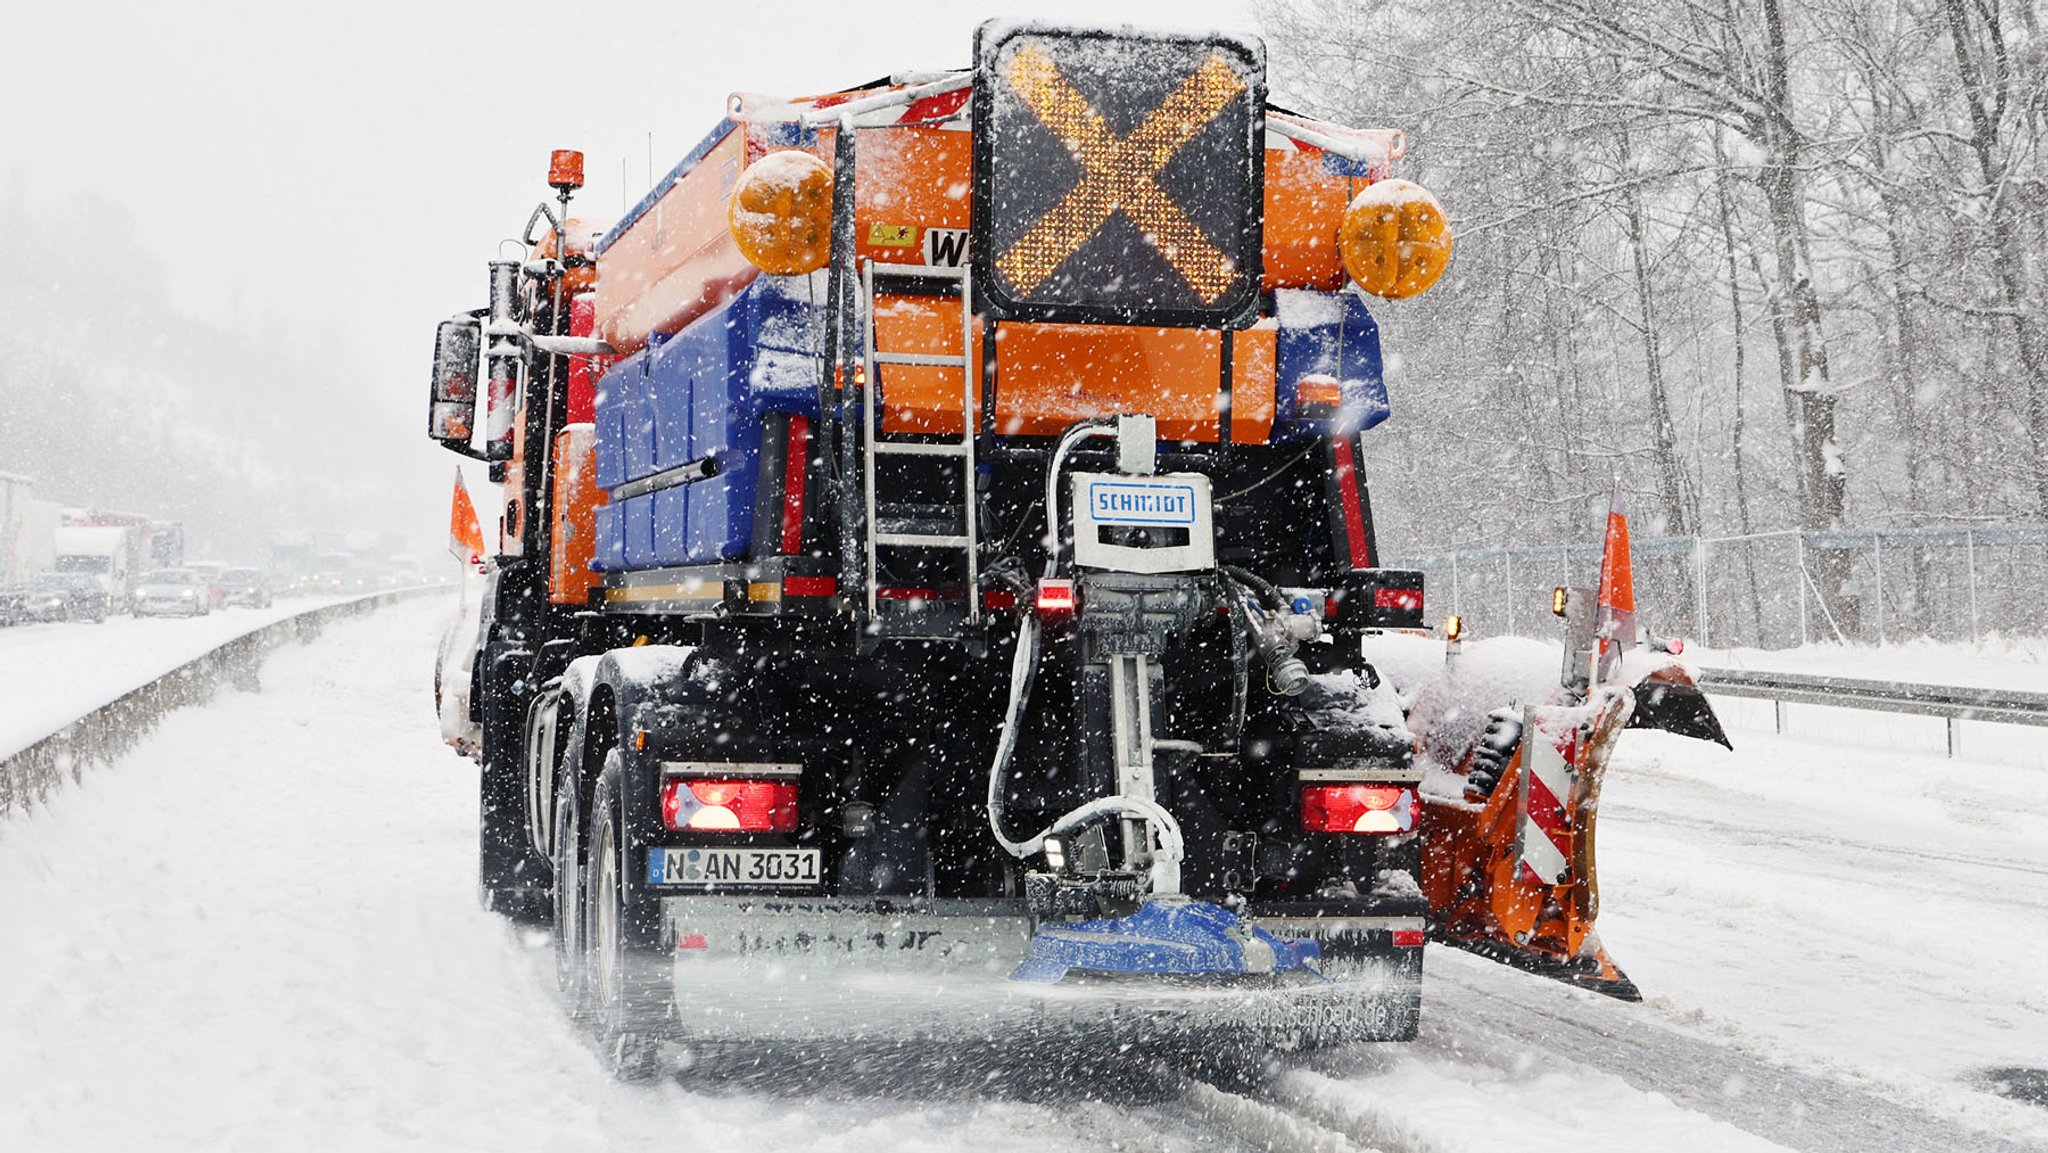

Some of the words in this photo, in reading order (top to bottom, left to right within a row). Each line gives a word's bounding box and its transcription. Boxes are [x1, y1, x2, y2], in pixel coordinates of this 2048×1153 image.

[1099, 493, 1185, 513] SCHMIDT
[666, 853, 684, 879] N
[704, 853, 740, 880] AN
[748, 853, 816, 880] 3031
